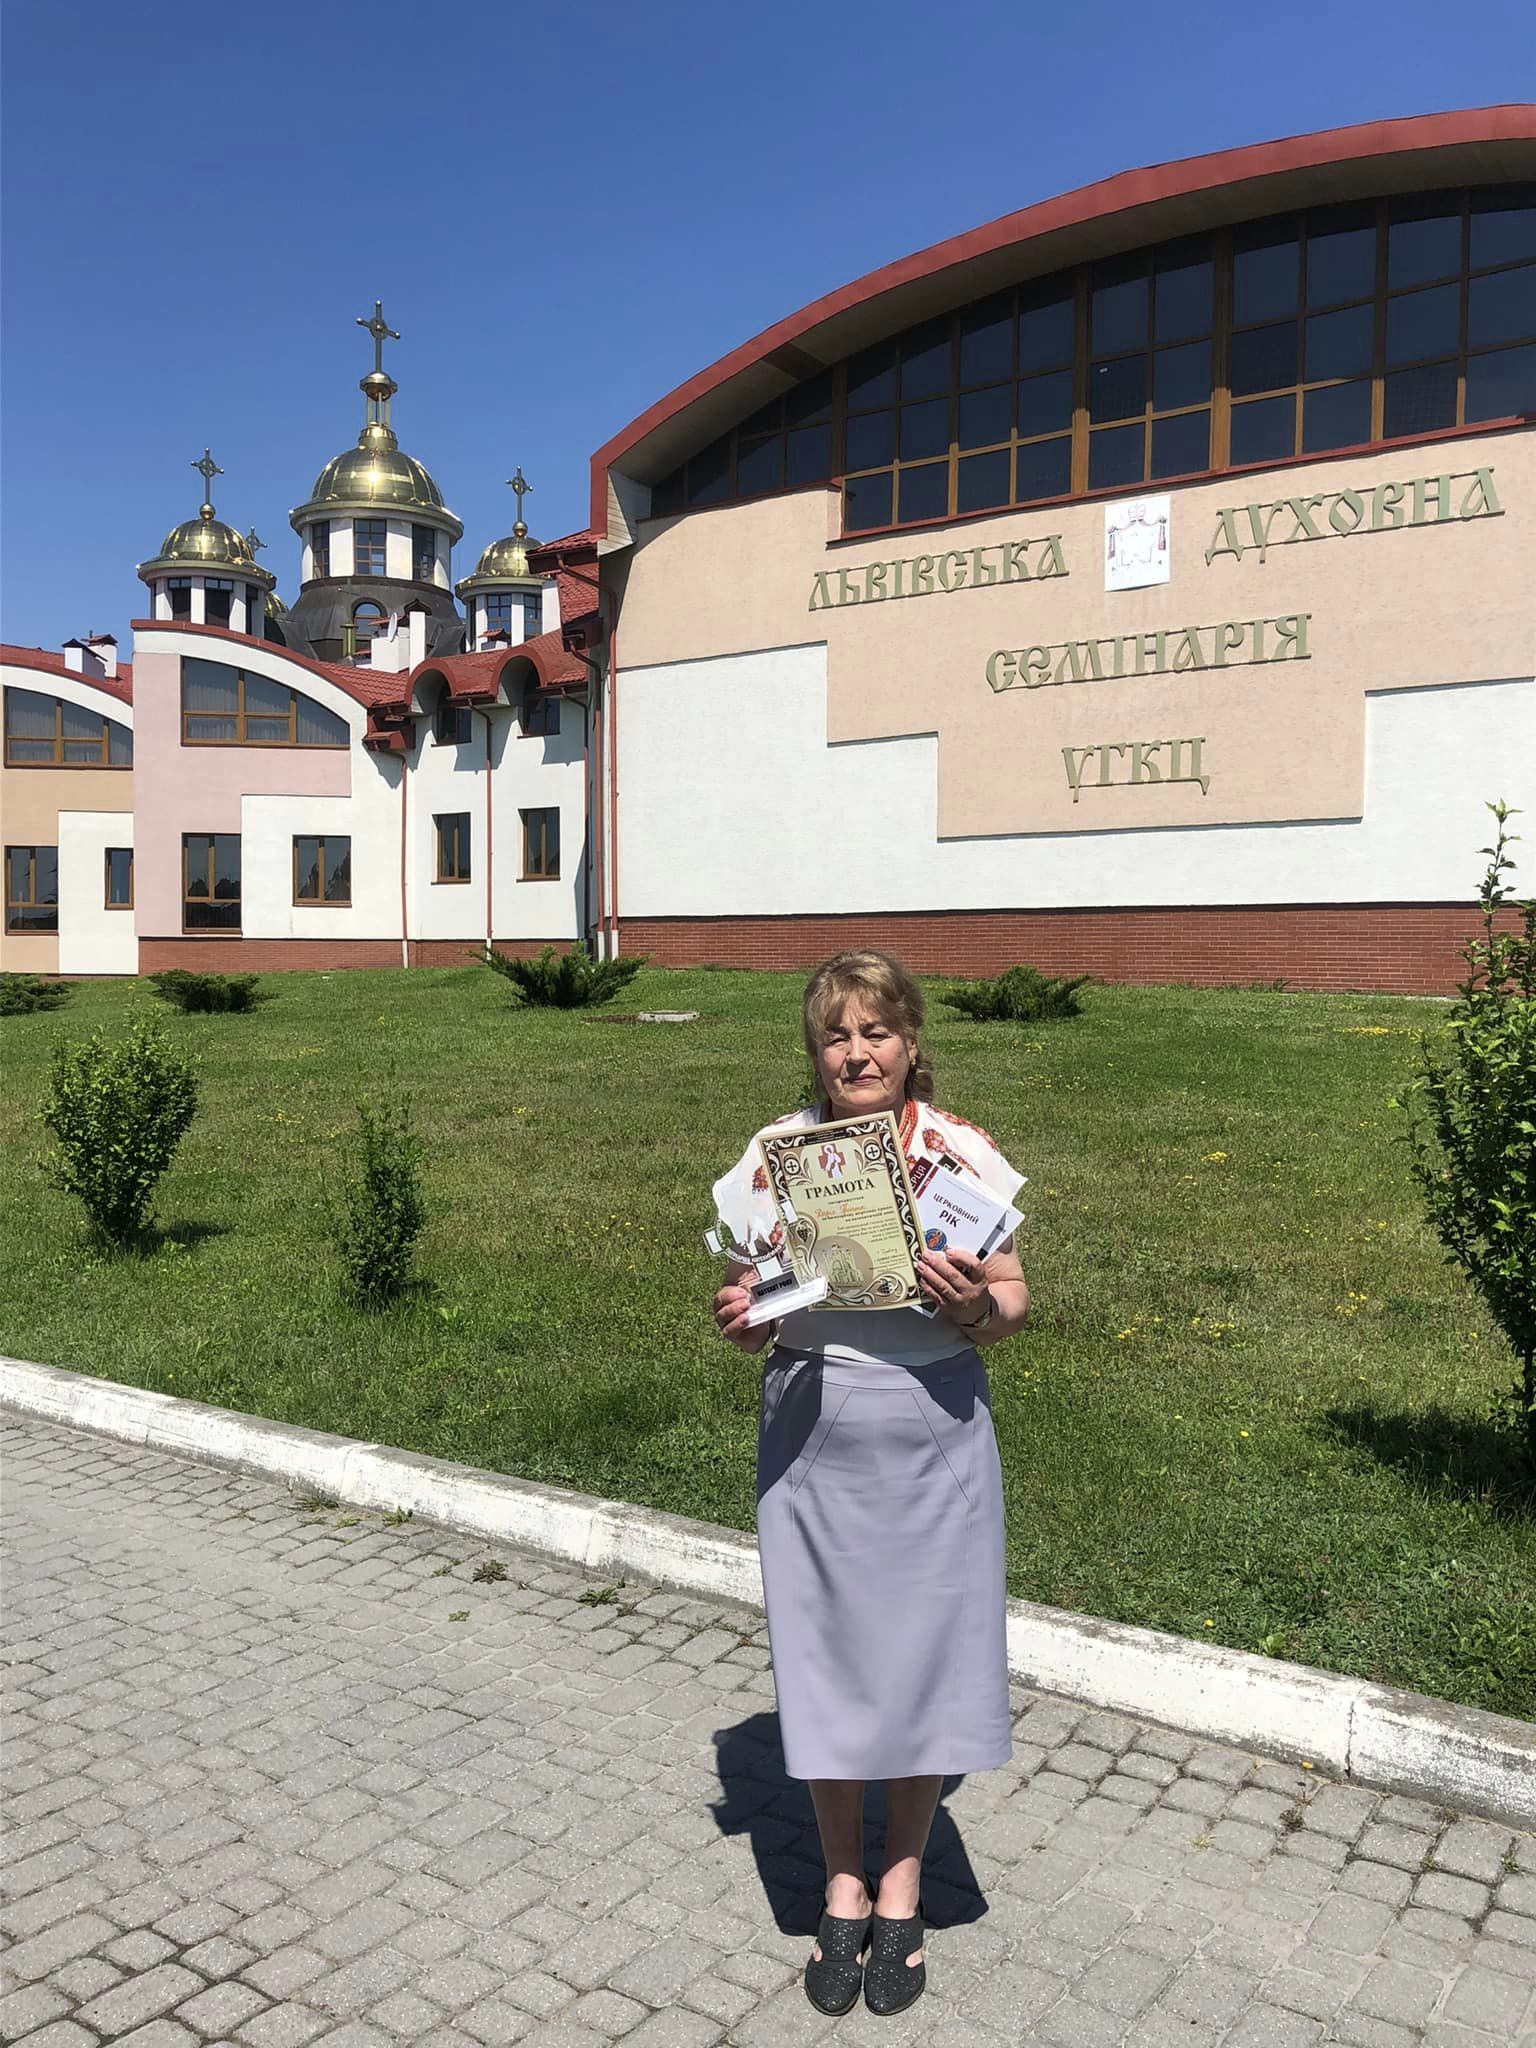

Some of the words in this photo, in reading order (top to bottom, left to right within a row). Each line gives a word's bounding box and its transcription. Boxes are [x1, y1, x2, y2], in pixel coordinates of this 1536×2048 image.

[808, 534, 1070, 610] ЛЬВІВСЬКА
[1205, 466, 1505, 565] ДУХОВНА
[986, 613, 1312, 691] СЕМІНАРІЯ
[1062, 737, 1210, 802] УГКЦ
[804, 1177, 875, 1200] ГРАМОТА
[932, 1192, 979, 1225] ЦЕРКОВНИЙ
[939, 1209, 961, 1228] РІК
